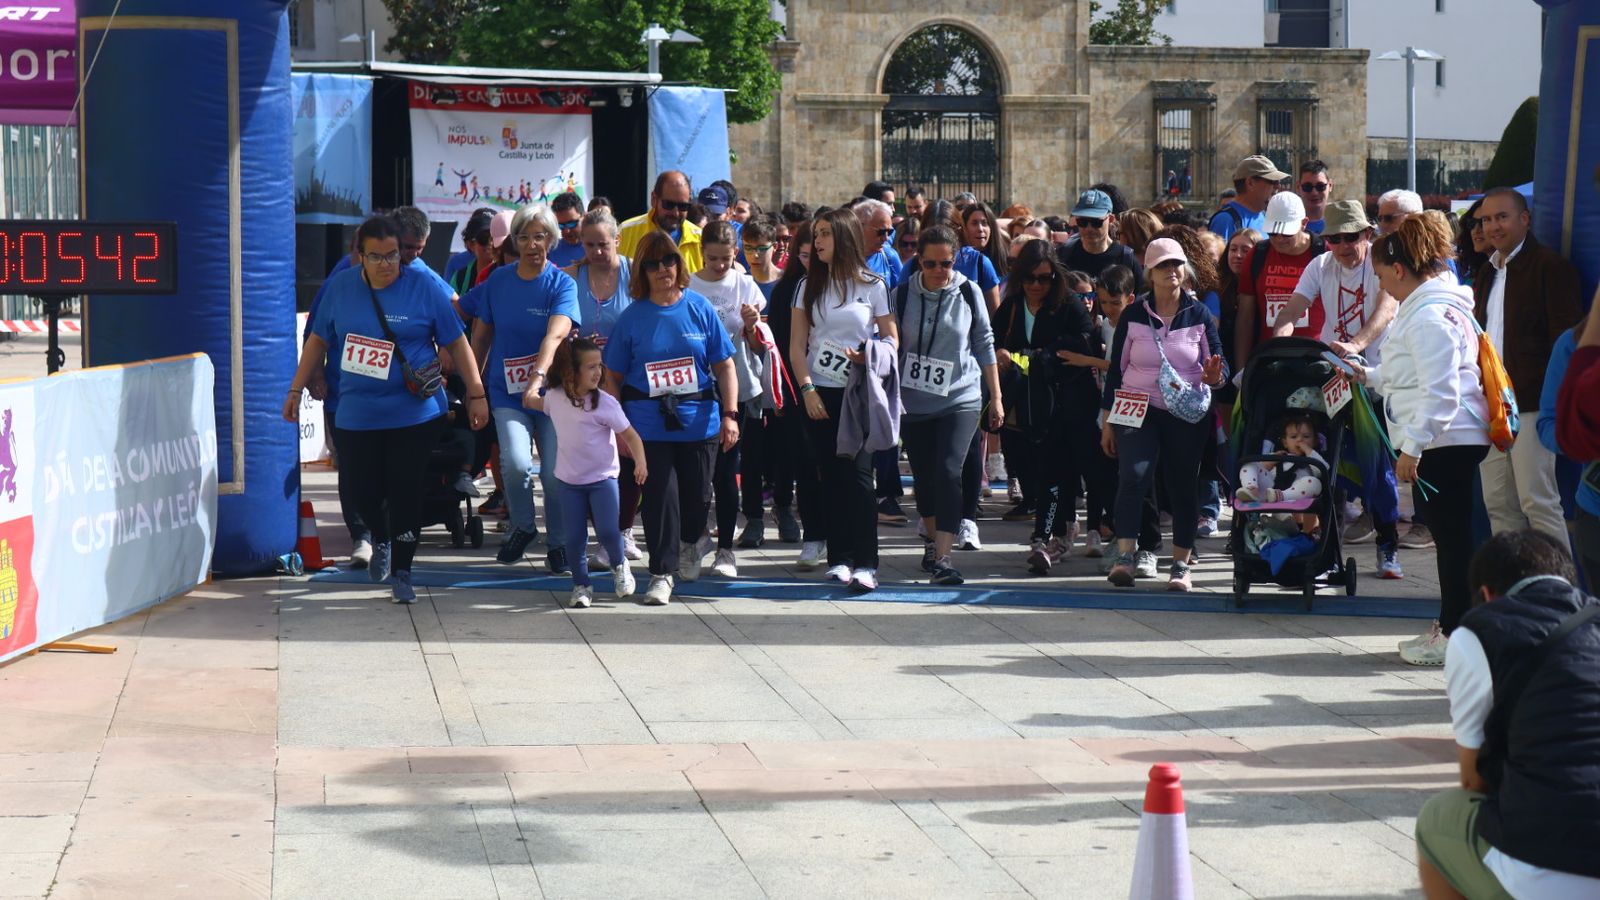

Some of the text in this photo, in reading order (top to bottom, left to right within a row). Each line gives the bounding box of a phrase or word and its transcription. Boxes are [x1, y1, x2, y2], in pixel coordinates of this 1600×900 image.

[0, 48, 75, 81] or
[448, 126, 466, 134] NOS
[499, 151, 527, 159] Castilla
[536, 151, 554, 159] León
[520, 141, 554, 149] Junta de
[347, 345, 390, 369] 1123
[651, 367, 693, 388] 1181
[910, 361, 946, 386] 813
[1114, 399, 1146, 418] 1275
[153, 497, 165, 534] Y
[168, 480, 200, 530] LEÓ
[1044, 502, 1058, 534] adidas
